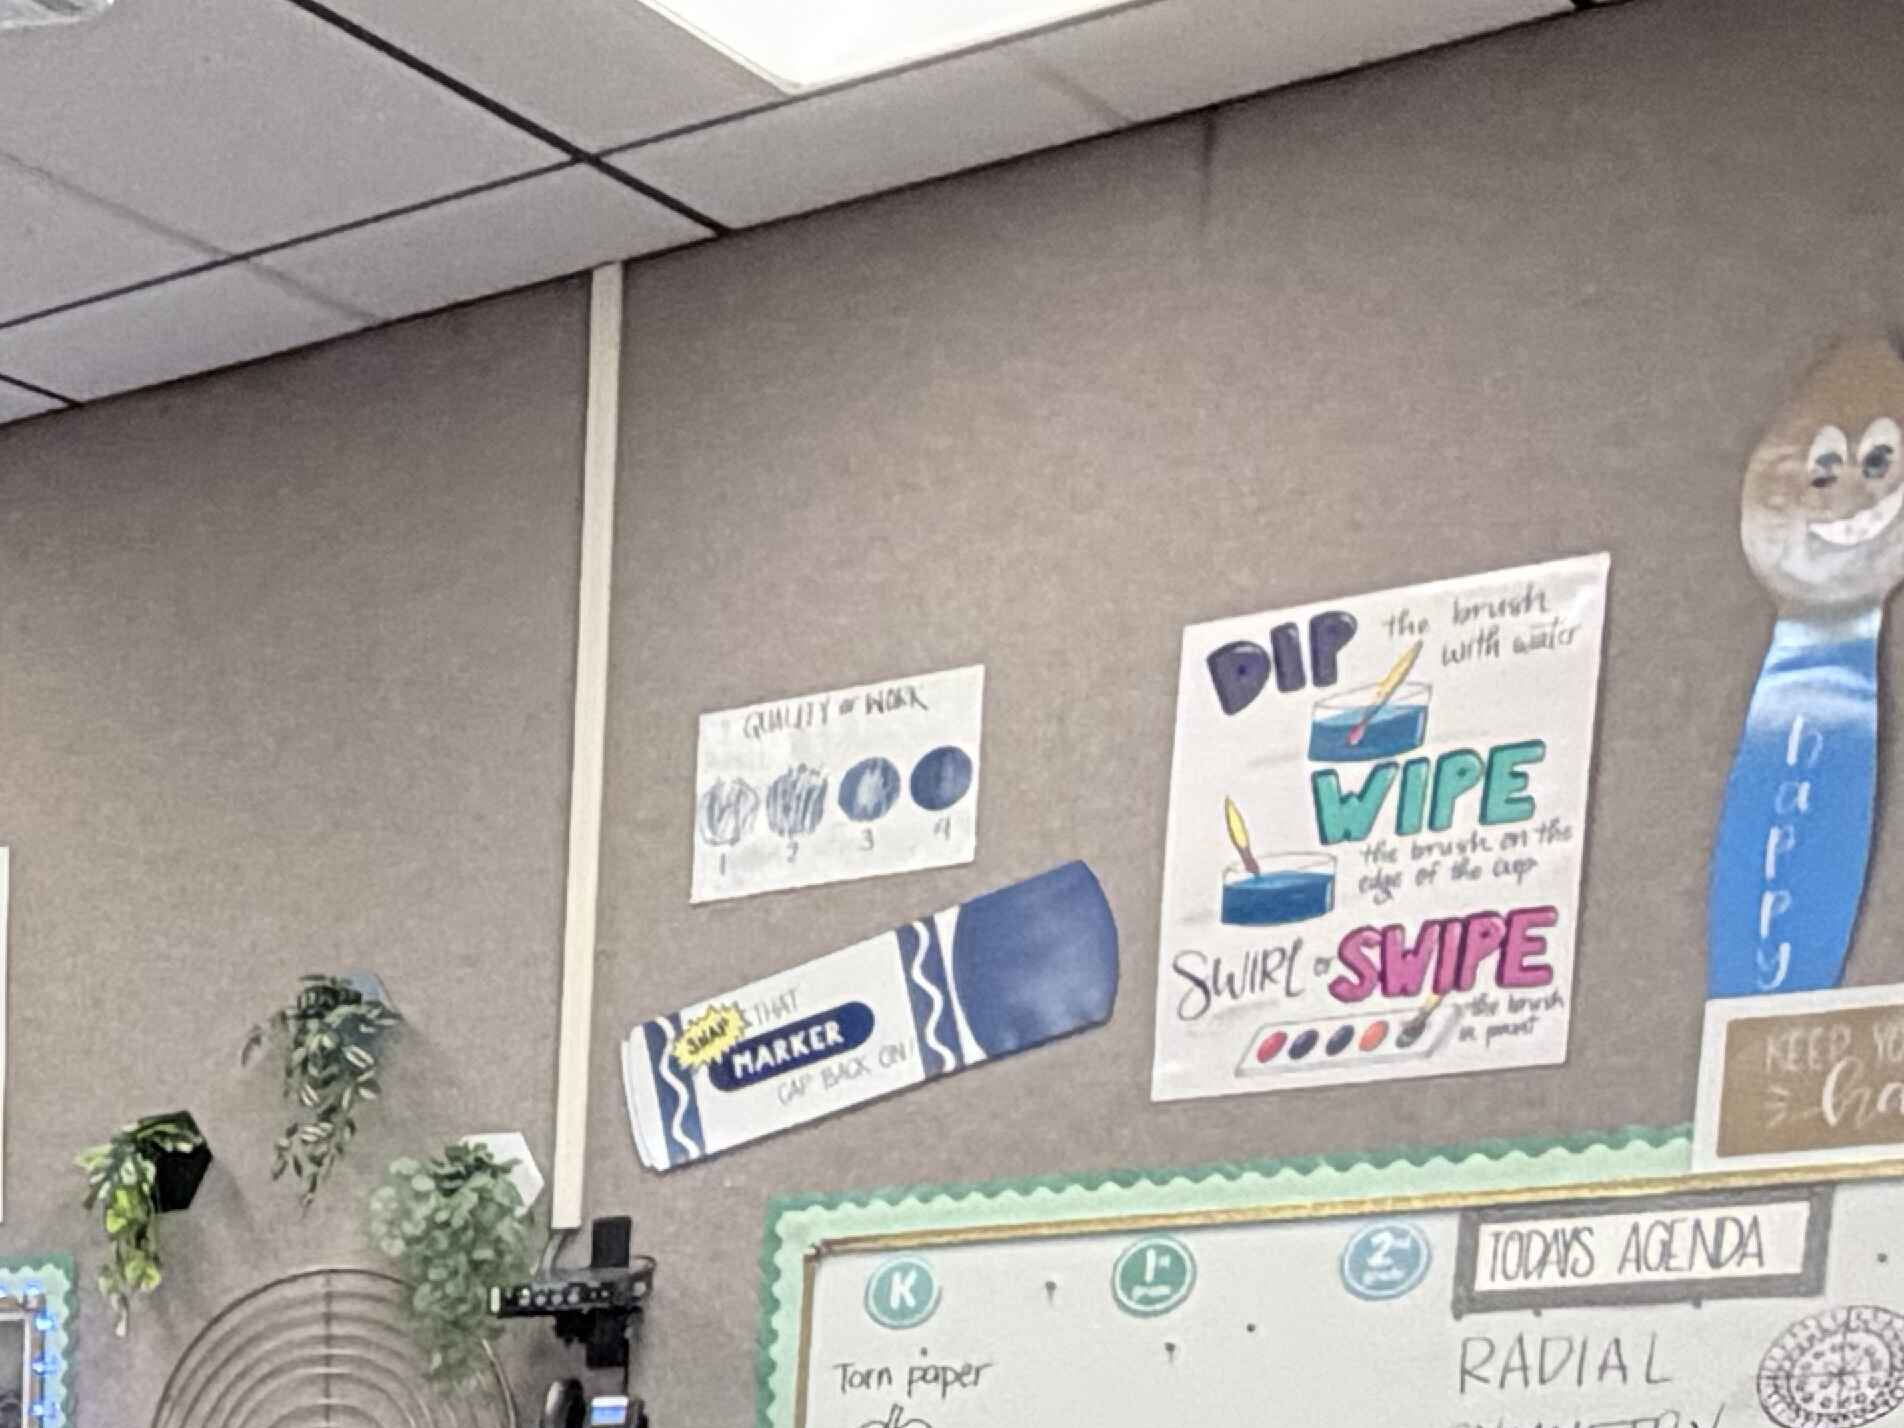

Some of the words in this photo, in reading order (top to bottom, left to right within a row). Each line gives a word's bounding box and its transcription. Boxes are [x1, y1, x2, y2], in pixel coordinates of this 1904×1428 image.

[1382, 609, 1429, 636] the
[1452, 584, 1551, 626] brush
[1206, 610, 1358, 716] DIP
[1441, 625, 1500, 667] with
[1512, 618, 1580, 655] water
[744, 697, 830, 739] QUALITY
[1311, 739, 1546, 845] WIPE
[1360, 841, 1398, 866] the
[1410, 829, 1492, 859] brush
[1498, 827, 1528, 849] on
[1535, 817, 1573, 846] the
[1757, 715, 1824, 991] happy
[1359, 865, 1402, 906] edge
[1416, 861, 1438, 886] of
[1451, 857, 1482, 881] the
[1173, 937, 1305, 1021] SWIRL
[1328, 905, 1559, 1004] SWIPE
[754, 987, 801, 1026] THAT
[1462, 989, 1499, 1018] the
[731, 1020, 845, 1080] MARKER
[1766, 1025, 1853, 1074] KEEP
[776, 1078, 815, 1105] CAP
[820, 1057, 872, 1091] BACK
[1489, 1225, 1595, 1283] TODAYS
[1618, 1214, 1765, 1275] AGENDA
[890, 1270, 918, 1310] K
[832, 1361, 893, 1395] Torn
[907, 1362, 997, 1401] paper
[1459, 1331, 1674, 1396] RADIAL
